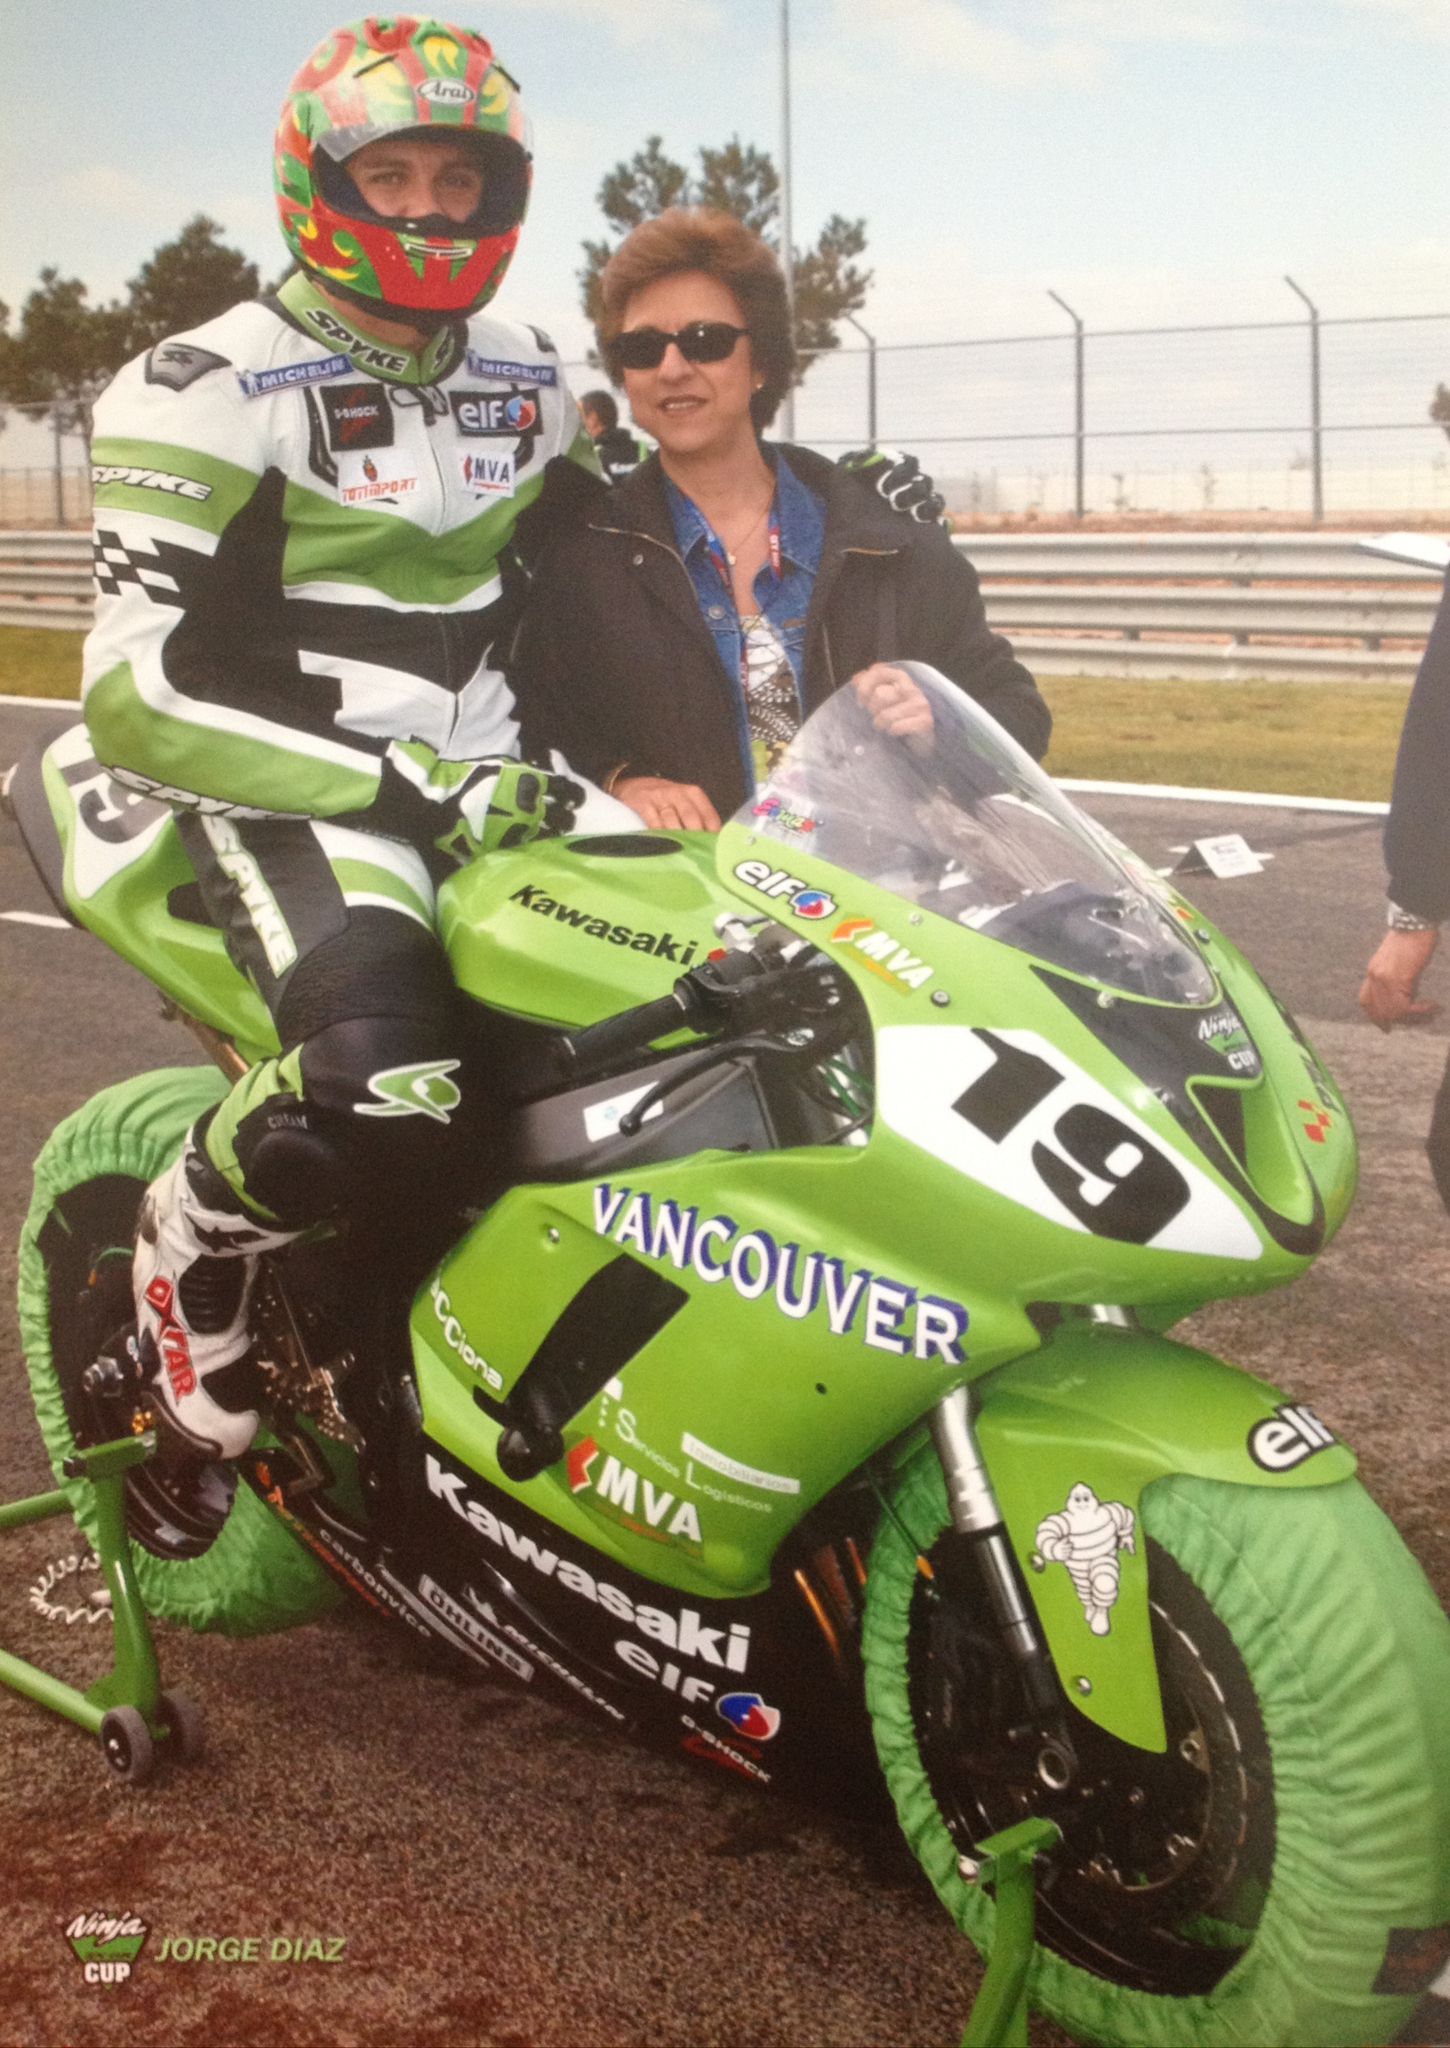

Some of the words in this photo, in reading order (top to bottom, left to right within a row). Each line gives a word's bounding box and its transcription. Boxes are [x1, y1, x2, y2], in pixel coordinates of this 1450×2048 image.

[421, 81, 467, 99] Arai
[261, 356, 346, 389] MICHELIN
[306, 308, 410, 374] SPYKE
[481, 361, 554, 382] MICHELIN
[458, 400, 504, 429] elf
[474, 456, 511, 484] MVA
[733, 859, 808, 900] elf
[509, 884, 699, 966] Kawasaki
[854, 930, 935, 990] MVA
[952, 1027, 1192, 1246] 19
[593, 1183, 971, 1366] VANCOUVER
[596, 1455, 702, 1543] MVA
[426, 1453, 751, 1673] Kawasaki
[614, 1638, 716, 1704] elf
[680, 1713, 772, 1784] G-SHOCK
